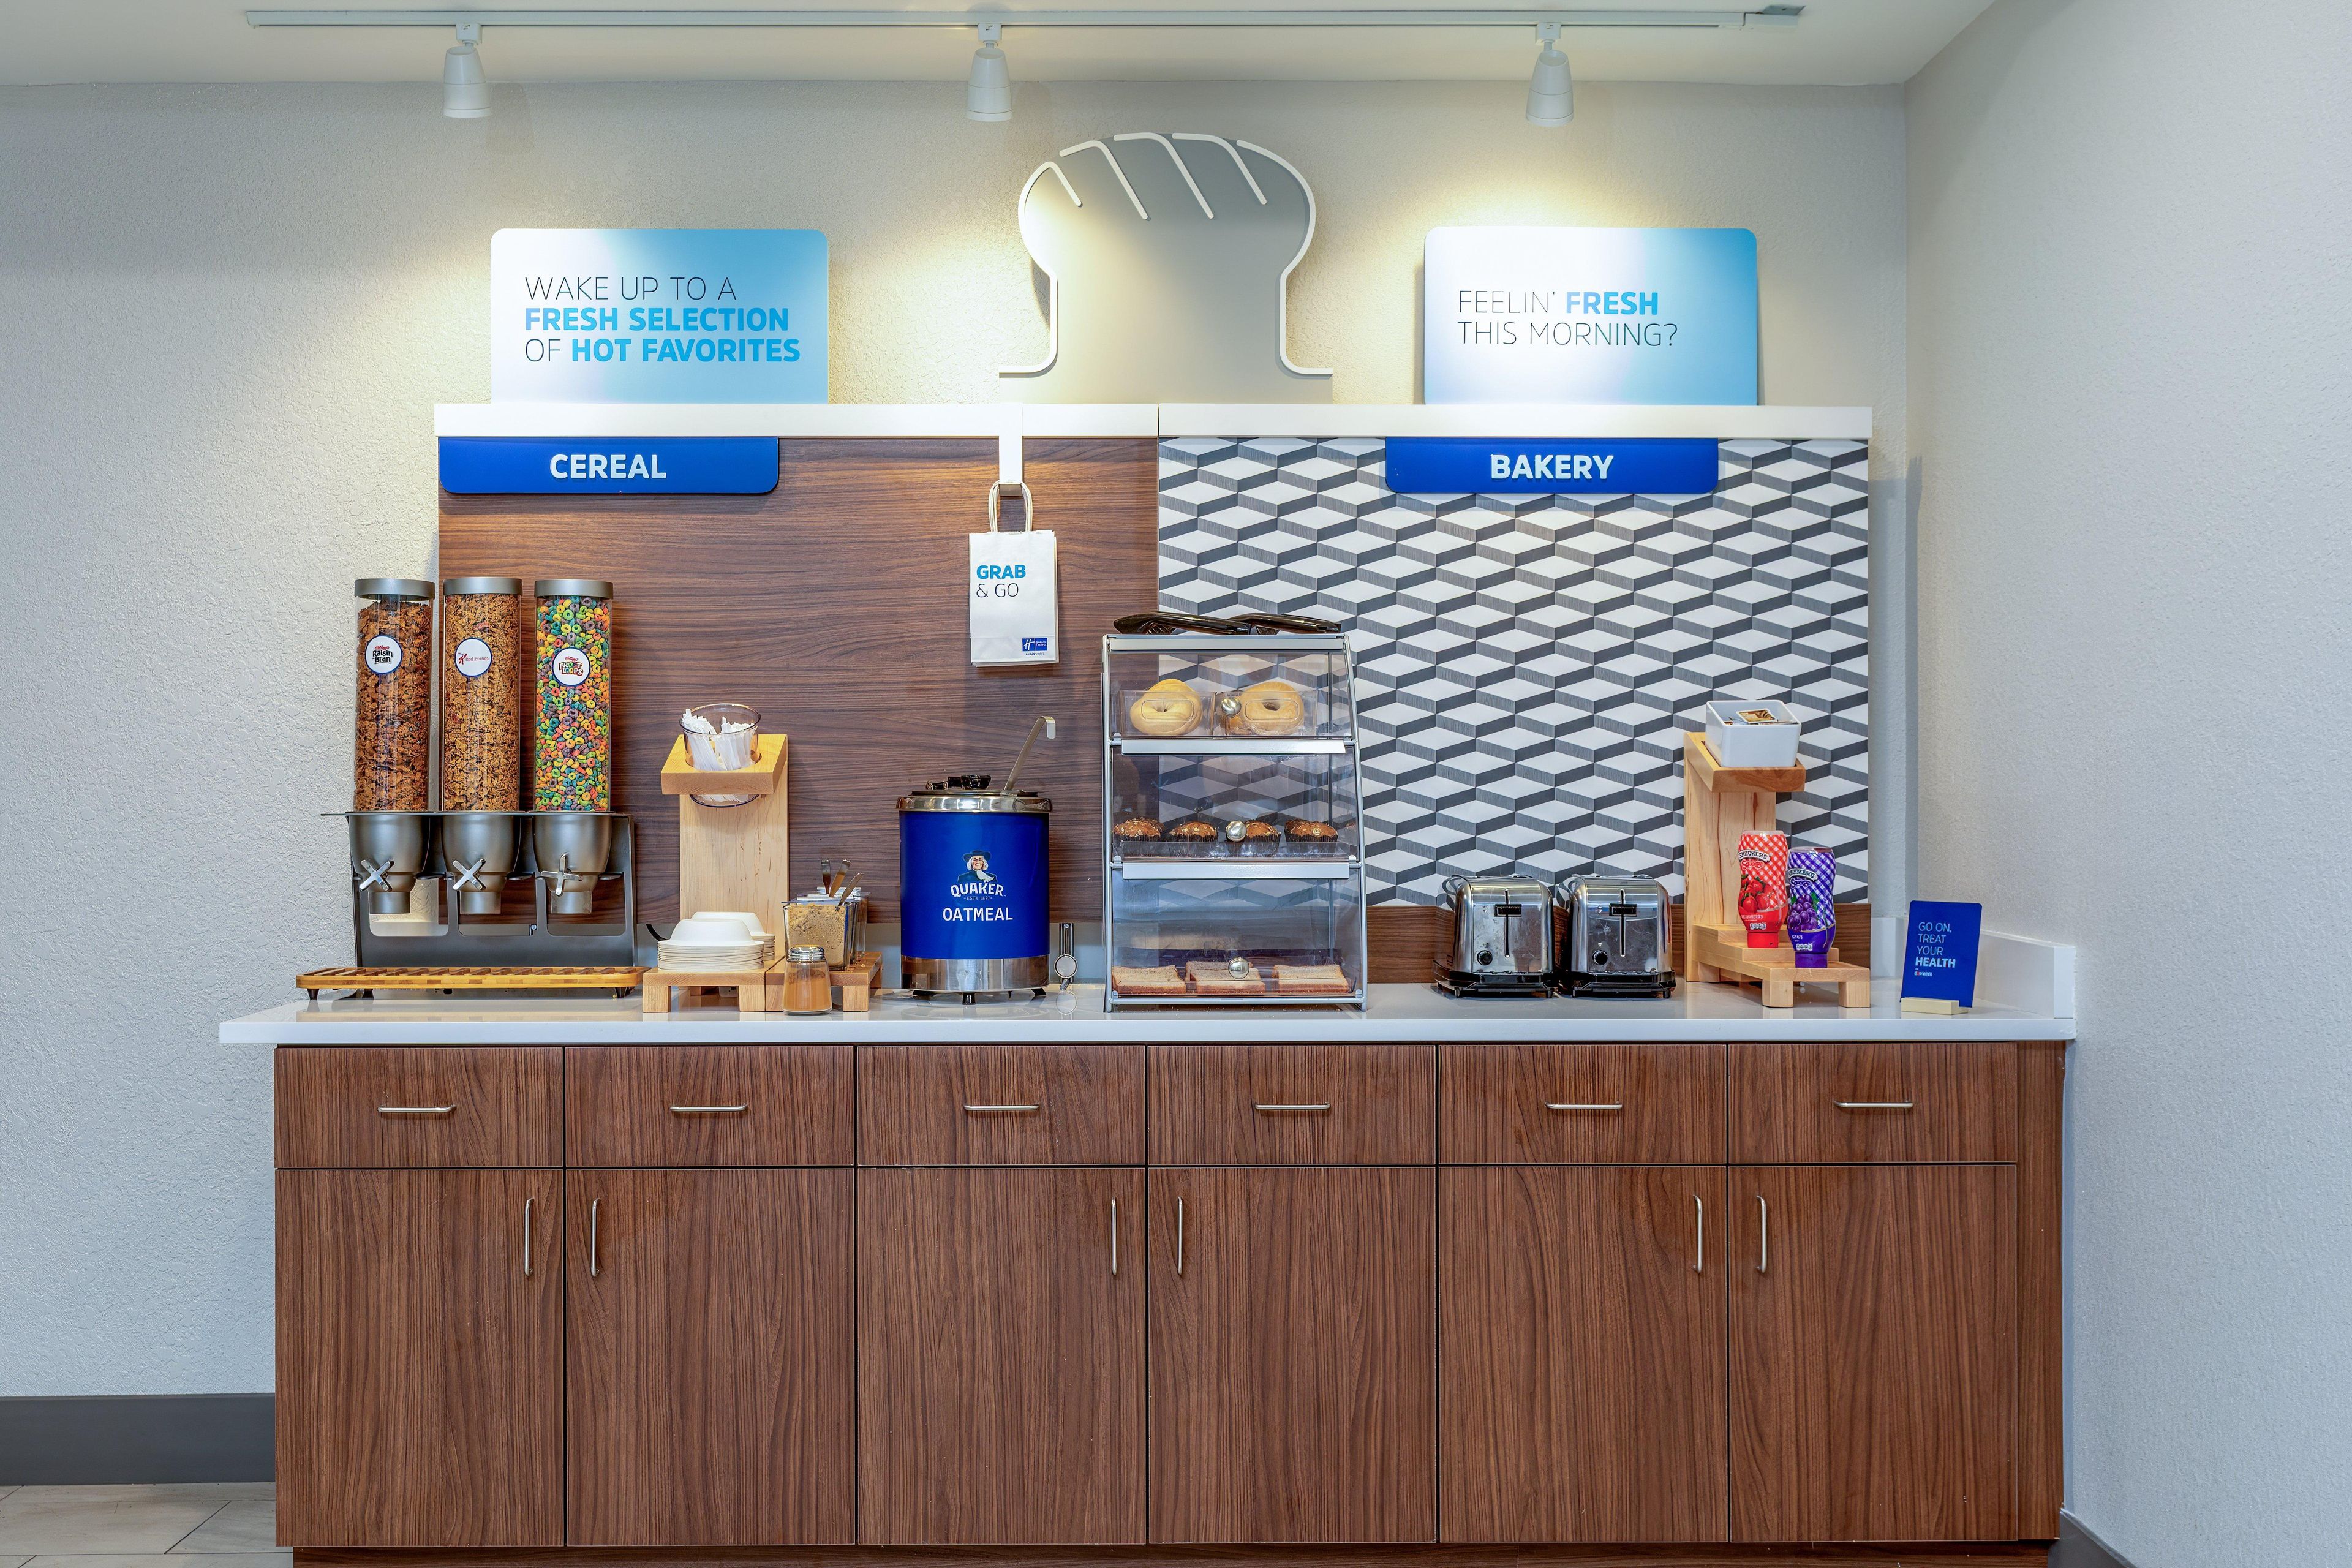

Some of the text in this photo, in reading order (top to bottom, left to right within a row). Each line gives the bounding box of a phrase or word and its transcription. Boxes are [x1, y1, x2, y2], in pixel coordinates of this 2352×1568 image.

[525, 276, 737, 300] WAKE UP TO A
[1458, 290, 1658, 315] FEELIN' FRESH
[525, 307, 789, 331] FRESH SELECTION
[1457, 321, 1678, 347] THIS MORNING?
[525, 338, 801, 362] OF HOT FAVORITES
[550, 454, 667, 479] CEREAL
[1490, 454, 1614, 480] BAKERY
[976, 564, 1027, 579] GRAB
[976, 582, 1019, 598] & GO
[562, 668, 584, 676] LOOPS
[950, 882, 1005, 898] QUAKER
[942, 907, 1014, 922] OATMEAL
[1918, 922, 1952, 933] GO ON,
[1918, 933, 1947, 944] TREAT
[1917, 945, 1943, 956] YOUR
[1915, 957, 1956, 968] HEALTH
